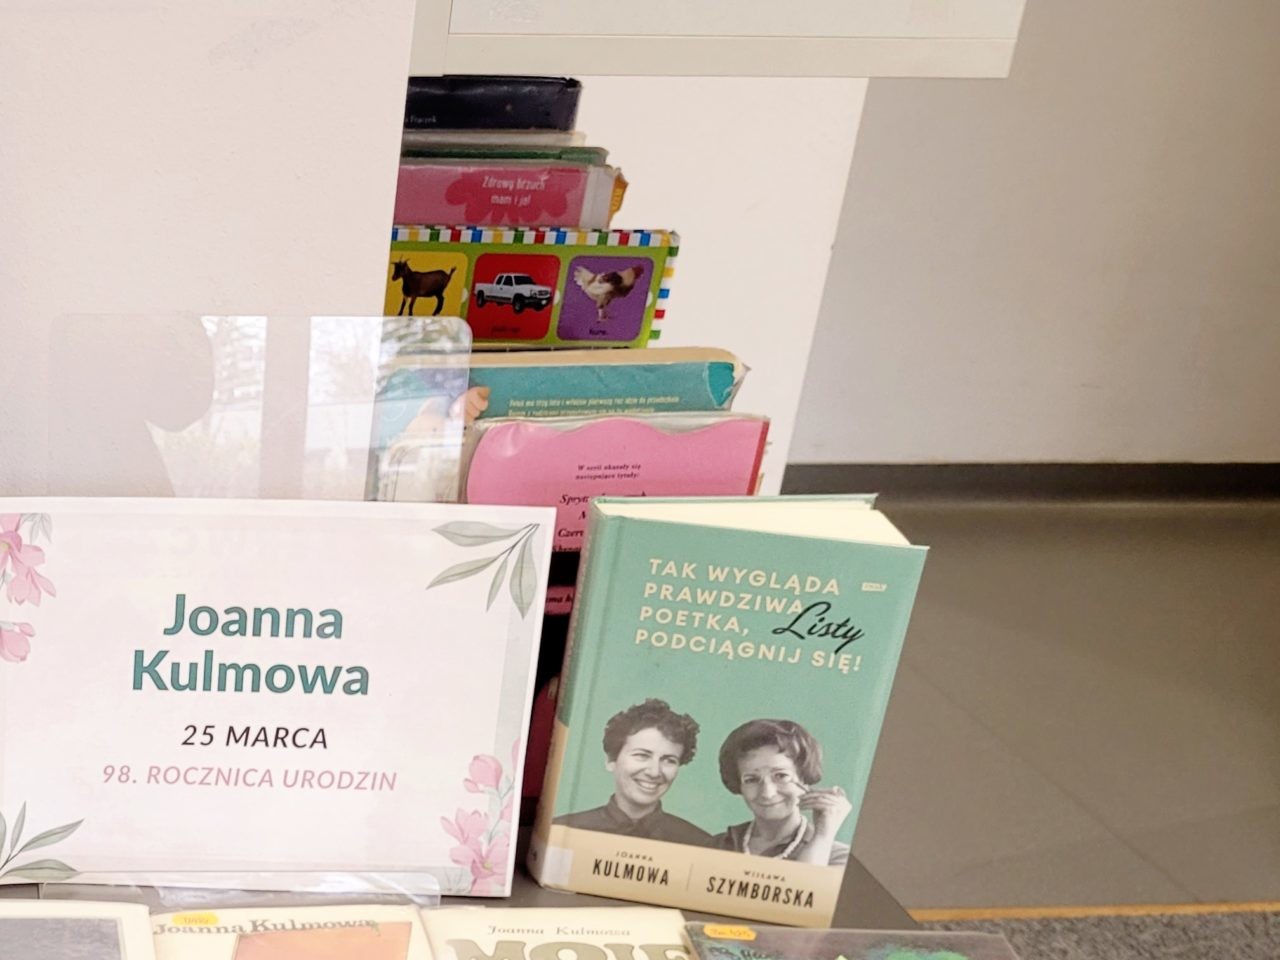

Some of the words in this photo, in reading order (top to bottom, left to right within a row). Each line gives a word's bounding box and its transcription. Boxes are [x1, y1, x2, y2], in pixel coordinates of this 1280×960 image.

[483, 175, 514, 190] Zdrowy
[490, 195, 512, 205] mam
[649, 559, 697, 579] TAK
[708, 565, 840, 596] WYGLĄDA
[644, 583, 803, 615] PRAWDZIWA
[163, 594, 343, 639] Joanna
[639, 606, 749, 636] POETKA,
[772, 601, 865, 655] Listy
[635, 629, 801, 664] PODCIĄGNIJ
[811, 650, 862, 674] SIĘ!
[132, 649, 370, 695] Kulmowa
[181, 725, 216, 746] 25
[225, 727, 328, 749] MARCA
[102, 765, 138, 784] 98.
[146, 766, 274, 788] ROCZNICA
[283, 769, 398, 792] URODZIN
[592, 858, 670, 886] KULMOWA
[706, 877, 815, 909] SZYMBORSKA
[153, 922, 247, 935] Joanna
[249, 919, 372, 932] Kulmowa
[488, 925, 544, 935] Joanna
[555, 926, 631, 936] Kulmowa
